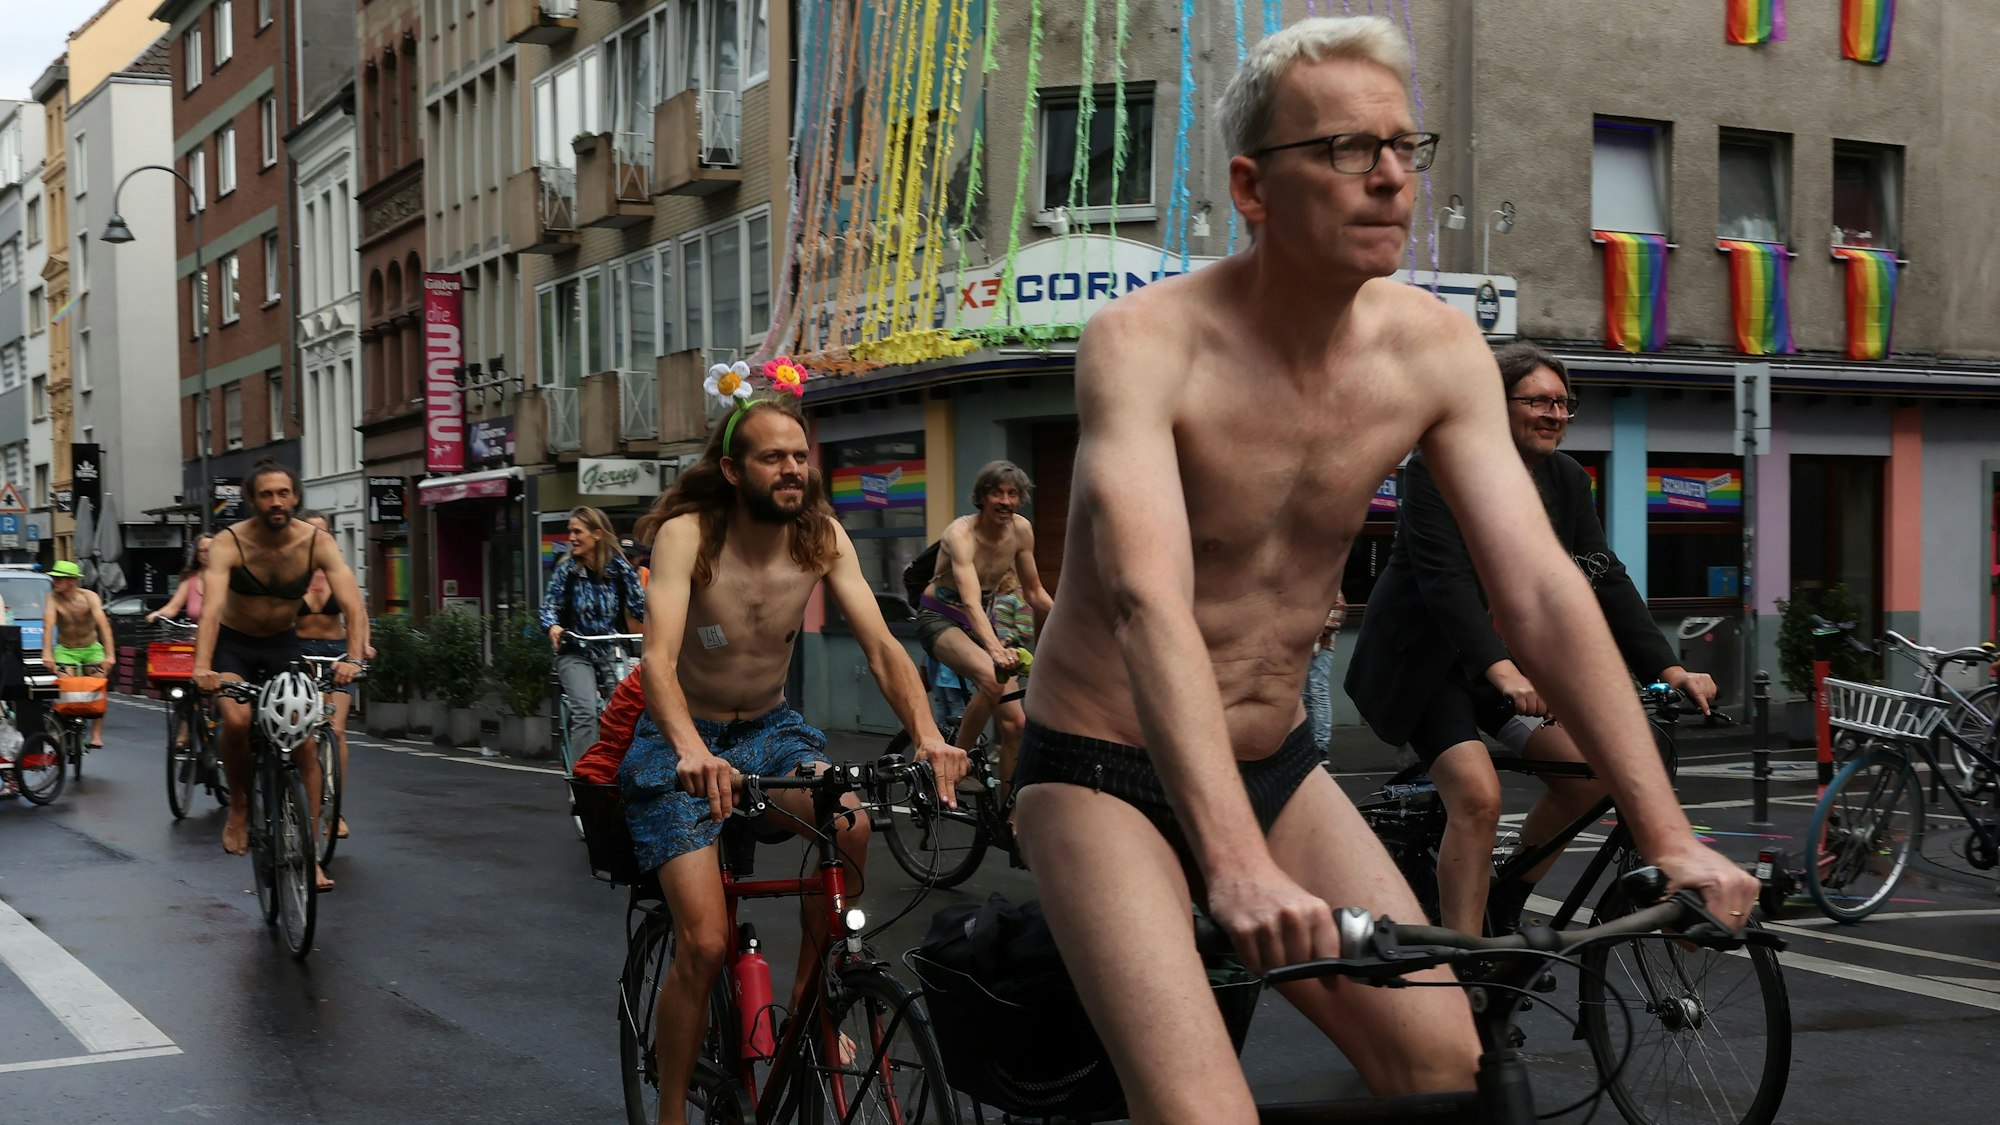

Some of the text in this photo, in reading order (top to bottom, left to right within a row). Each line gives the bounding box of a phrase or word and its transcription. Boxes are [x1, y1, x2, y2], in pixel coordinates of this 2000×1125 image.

[425, 301, 451, 322] die
[427, 324, 462, 441] mumu
[1663, 477, 1706, 499] SCHAAFEN
